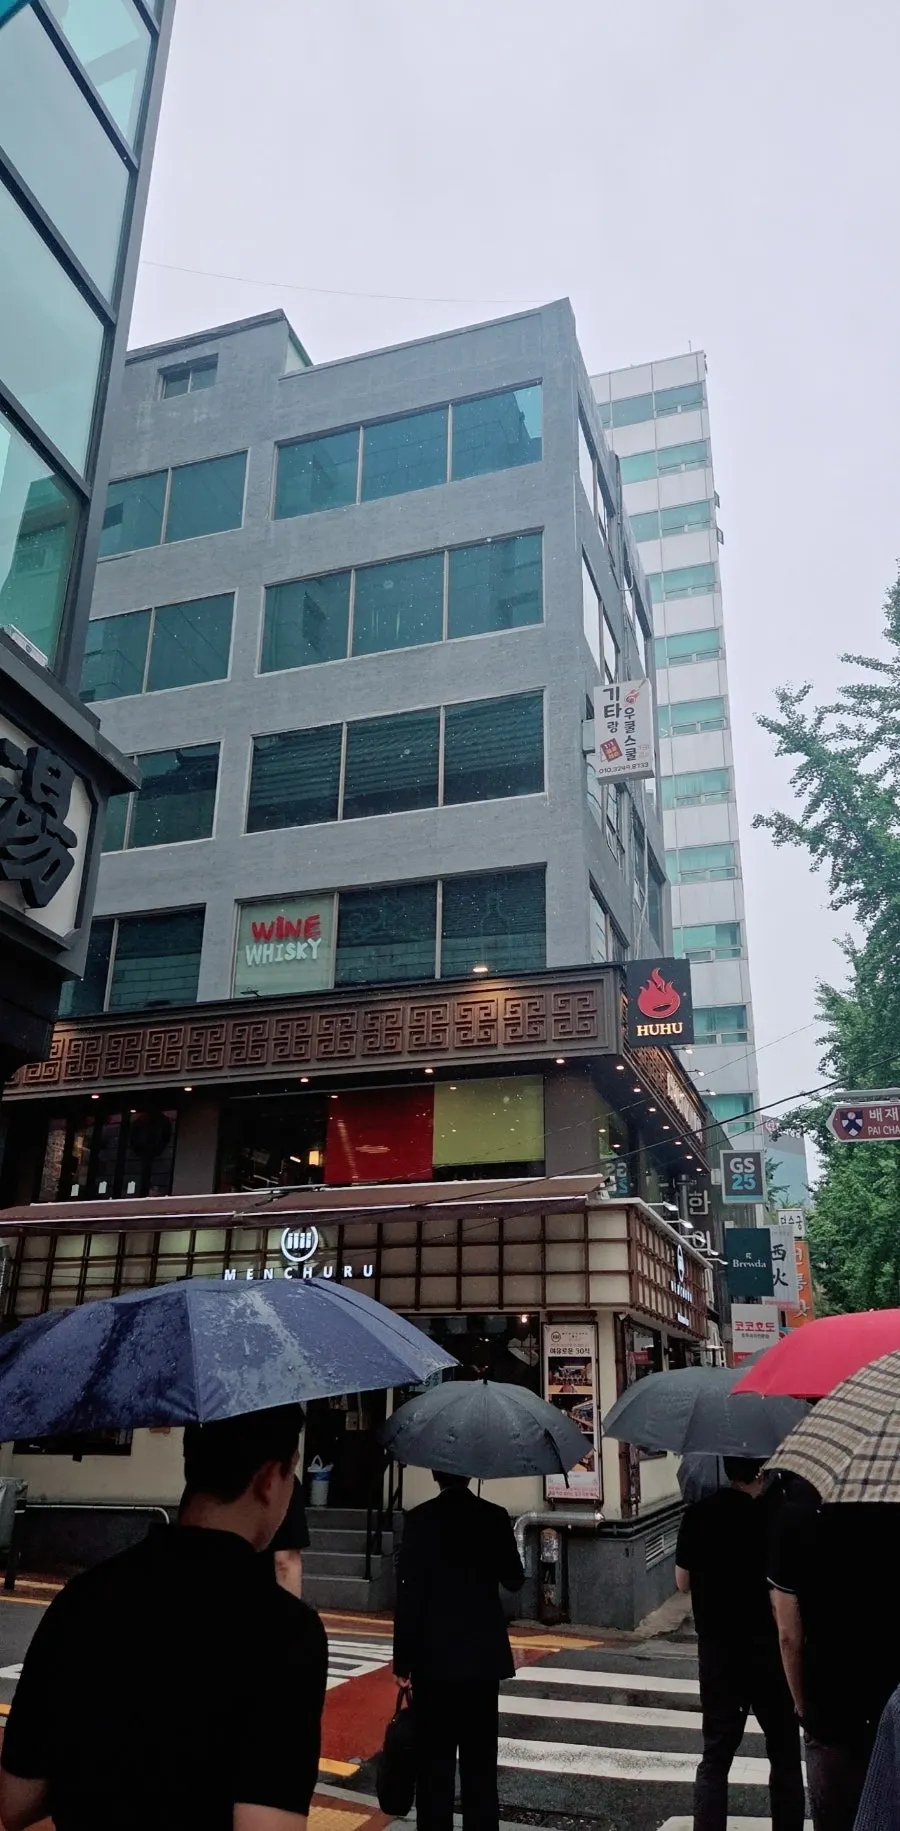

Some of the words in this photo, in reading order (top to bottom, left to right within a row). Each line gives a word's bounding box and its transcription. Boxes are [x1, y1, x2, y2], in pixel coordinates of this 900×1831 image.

[245, 938, 322, 966] WHISKY
[636, 1022, 683, 1037] HUHU
[869, 1106, 899, 1122] 배재
[867, 1126, 881, 1136] PAI
[729, 1157, 755, 1173] GS
[732, 1174, 756, 1191] 25
[732, 1259, 767, 1268] Brewda
[224, 1264, 373, 1280] MENCHURU
[735, 1320, 776, 1332] 코코호도
